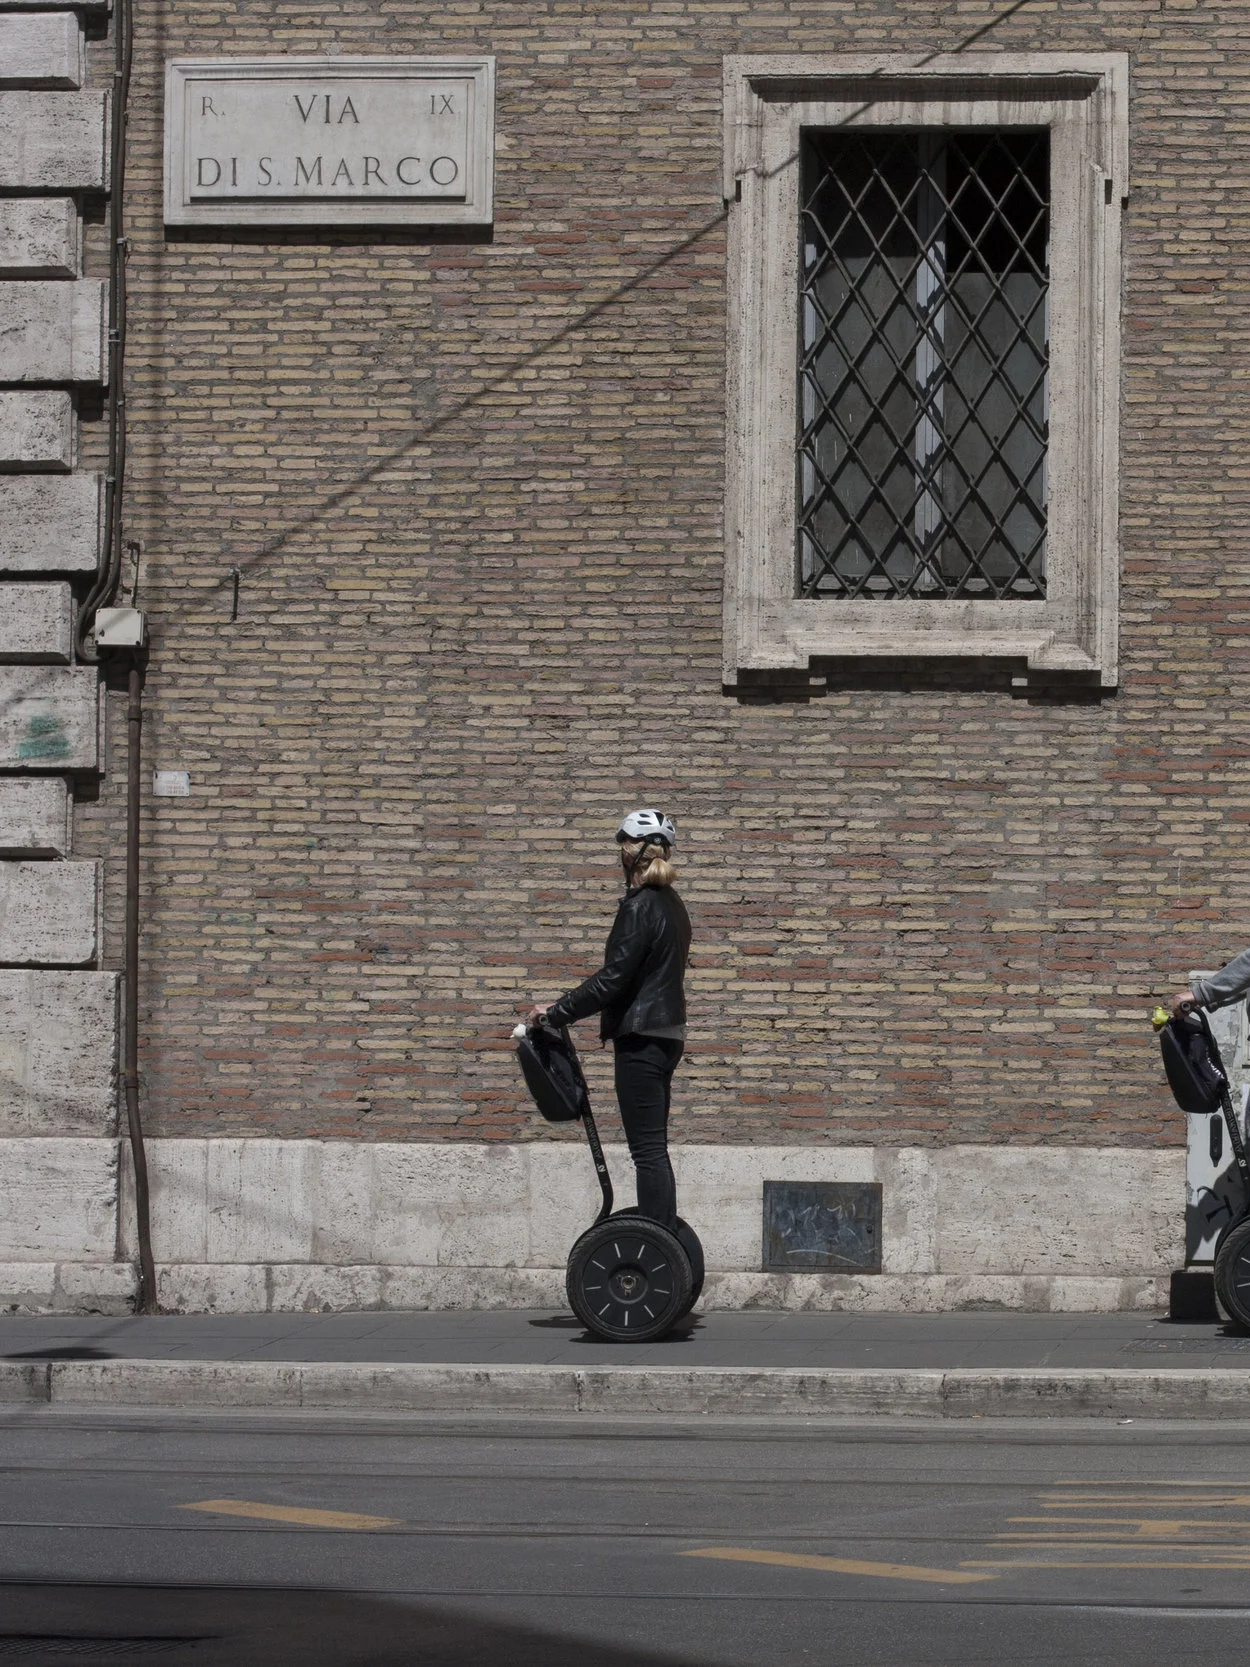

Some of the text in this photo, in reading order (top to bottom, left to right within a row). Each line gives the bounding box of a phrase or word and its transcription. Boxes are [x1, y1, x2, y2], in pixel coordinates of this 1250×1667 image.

[201, 96, 226, 116] R.
[292, 94, 361, 124] VIA
[429, 94, 455, 115] IX
[196, 155, 459, 187] DI S. MARCO
